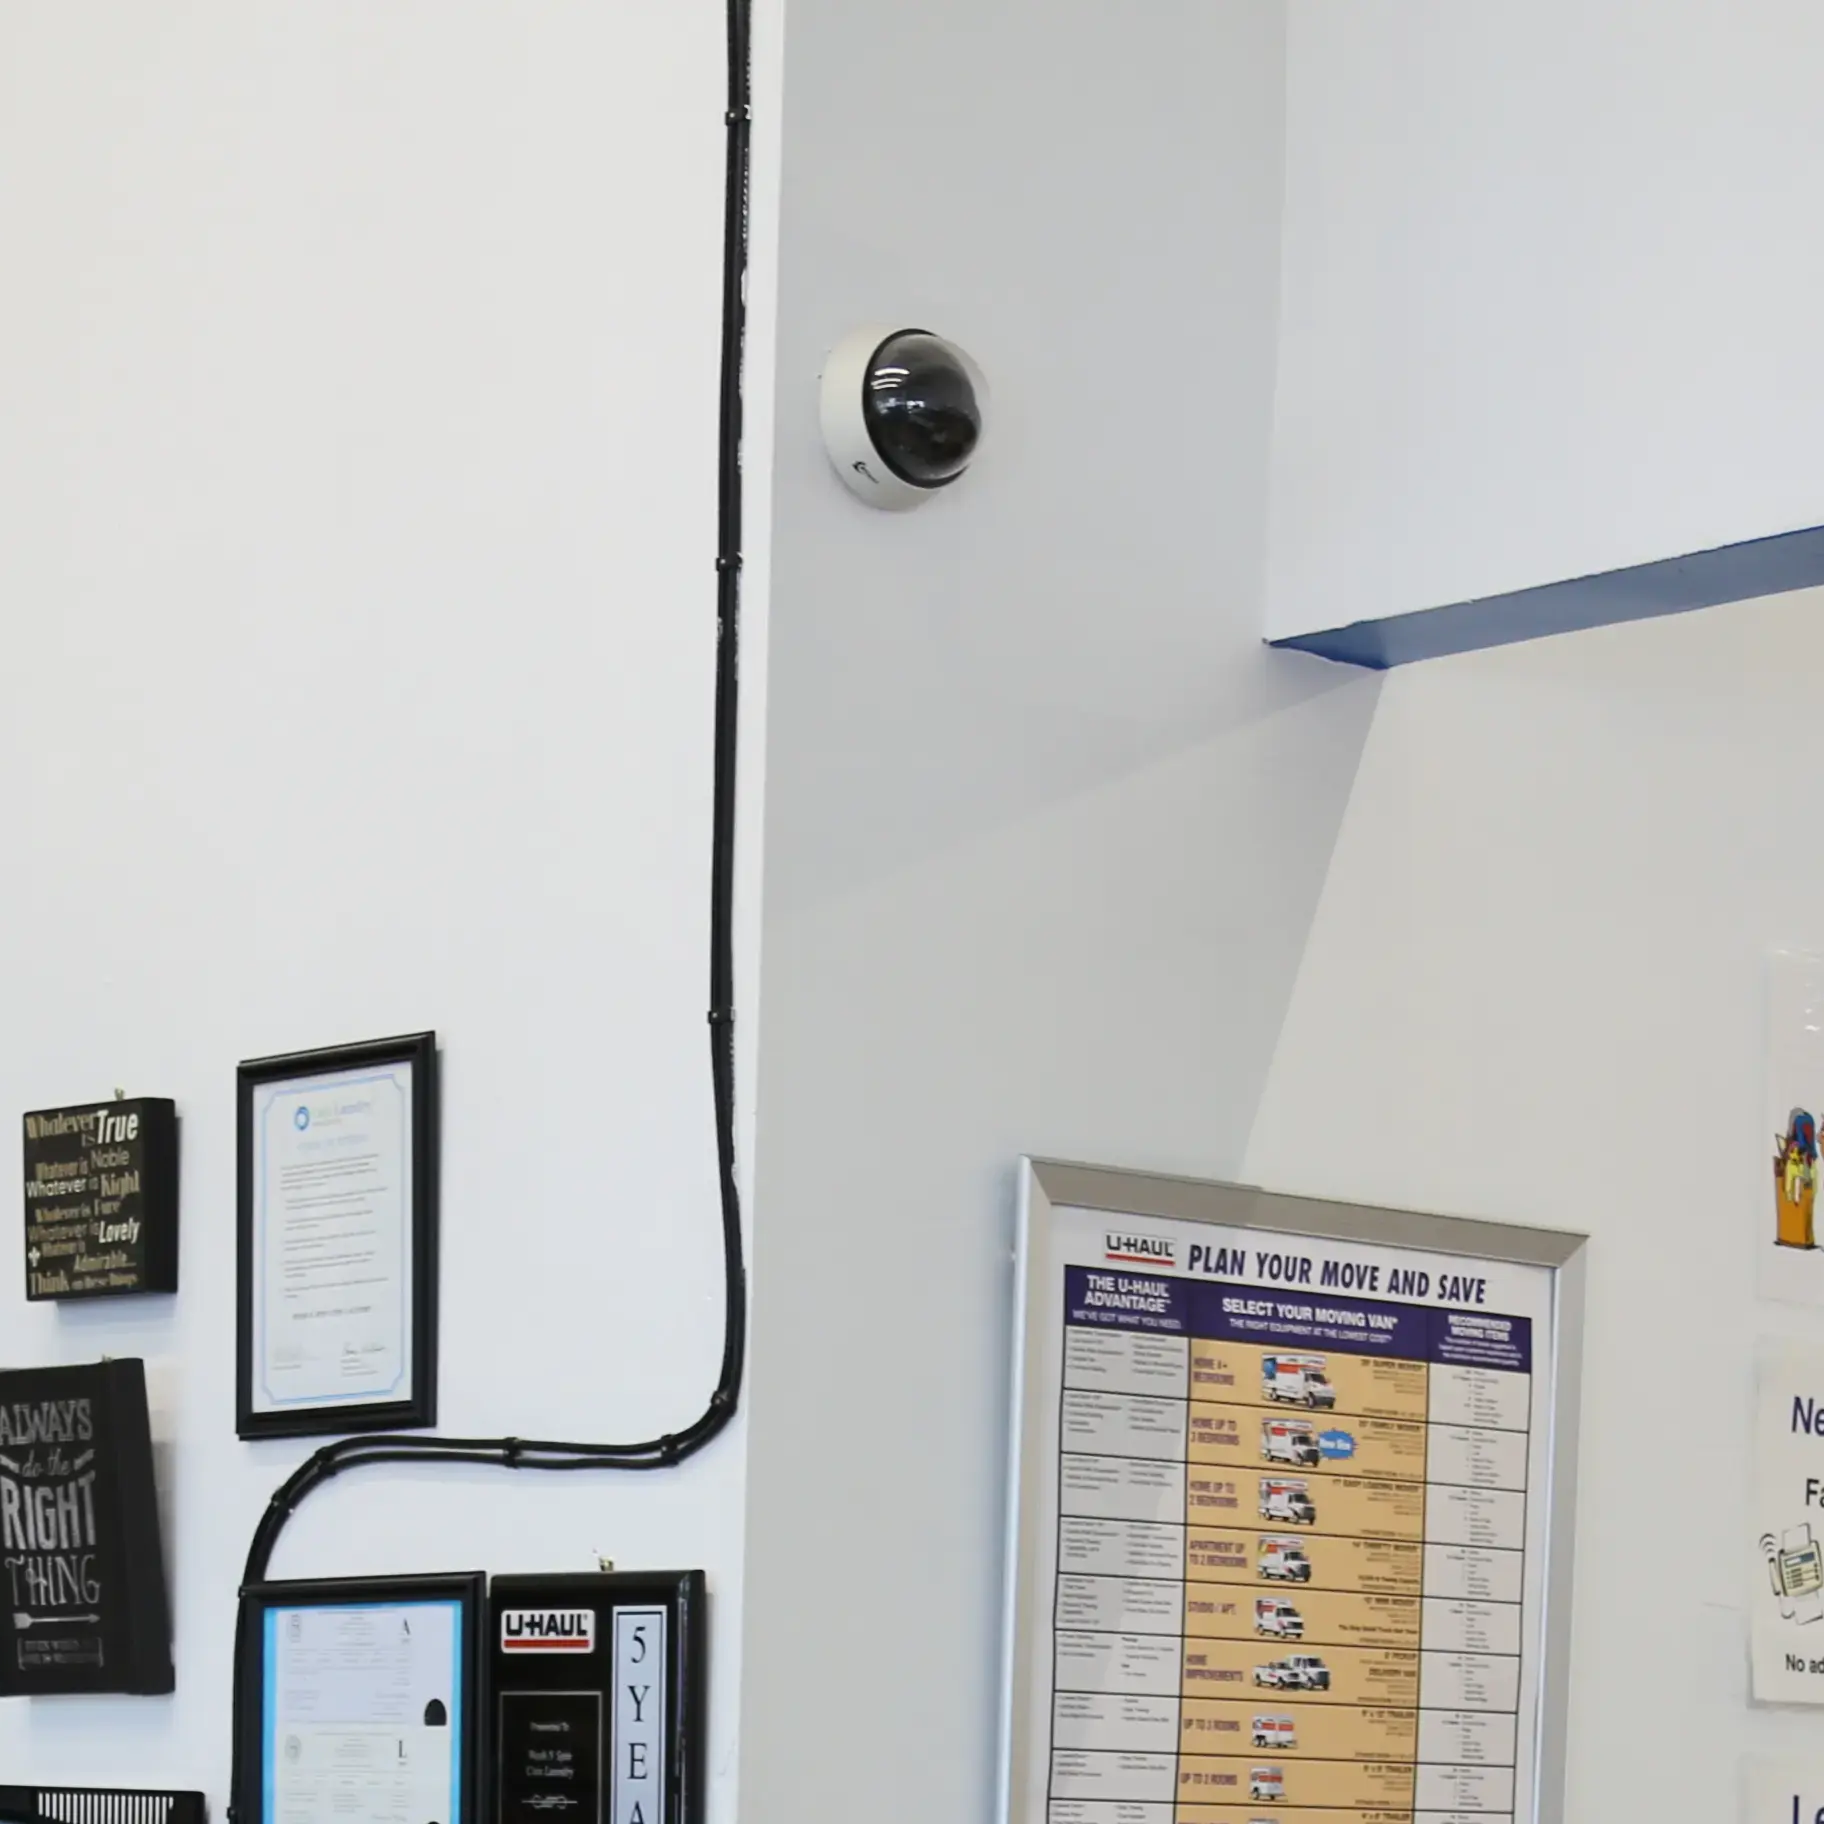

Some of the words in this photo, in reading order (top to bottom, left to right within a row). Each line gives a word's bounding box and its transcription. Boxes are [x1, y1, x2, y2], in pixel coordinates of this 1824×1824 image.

[97, 1110, 139, 1144] True
[91, 1148, 130, 1169] Noble
[26, 1177, 87, 1198] Whatever
[99, 1217, 140, 1244] Lovely
[1087, 1275, 1113, 1293] THE
[1188, 1245, 1246, 1277] PLAN
[1256, 1252, 1311, 1286] YOUR
[1320, 1259, 1379, 1293] MOVE
[1388, 1267, 1429, 1298] AND
[1437, 1274, 1486, 1305] SAVE
[47, 1449, 72, 1476] the
[0, 1470, 97, 1550] RIGHT
[5, 1554, 100, 1605] THING
[630, 1626, 646, 1663] 5
